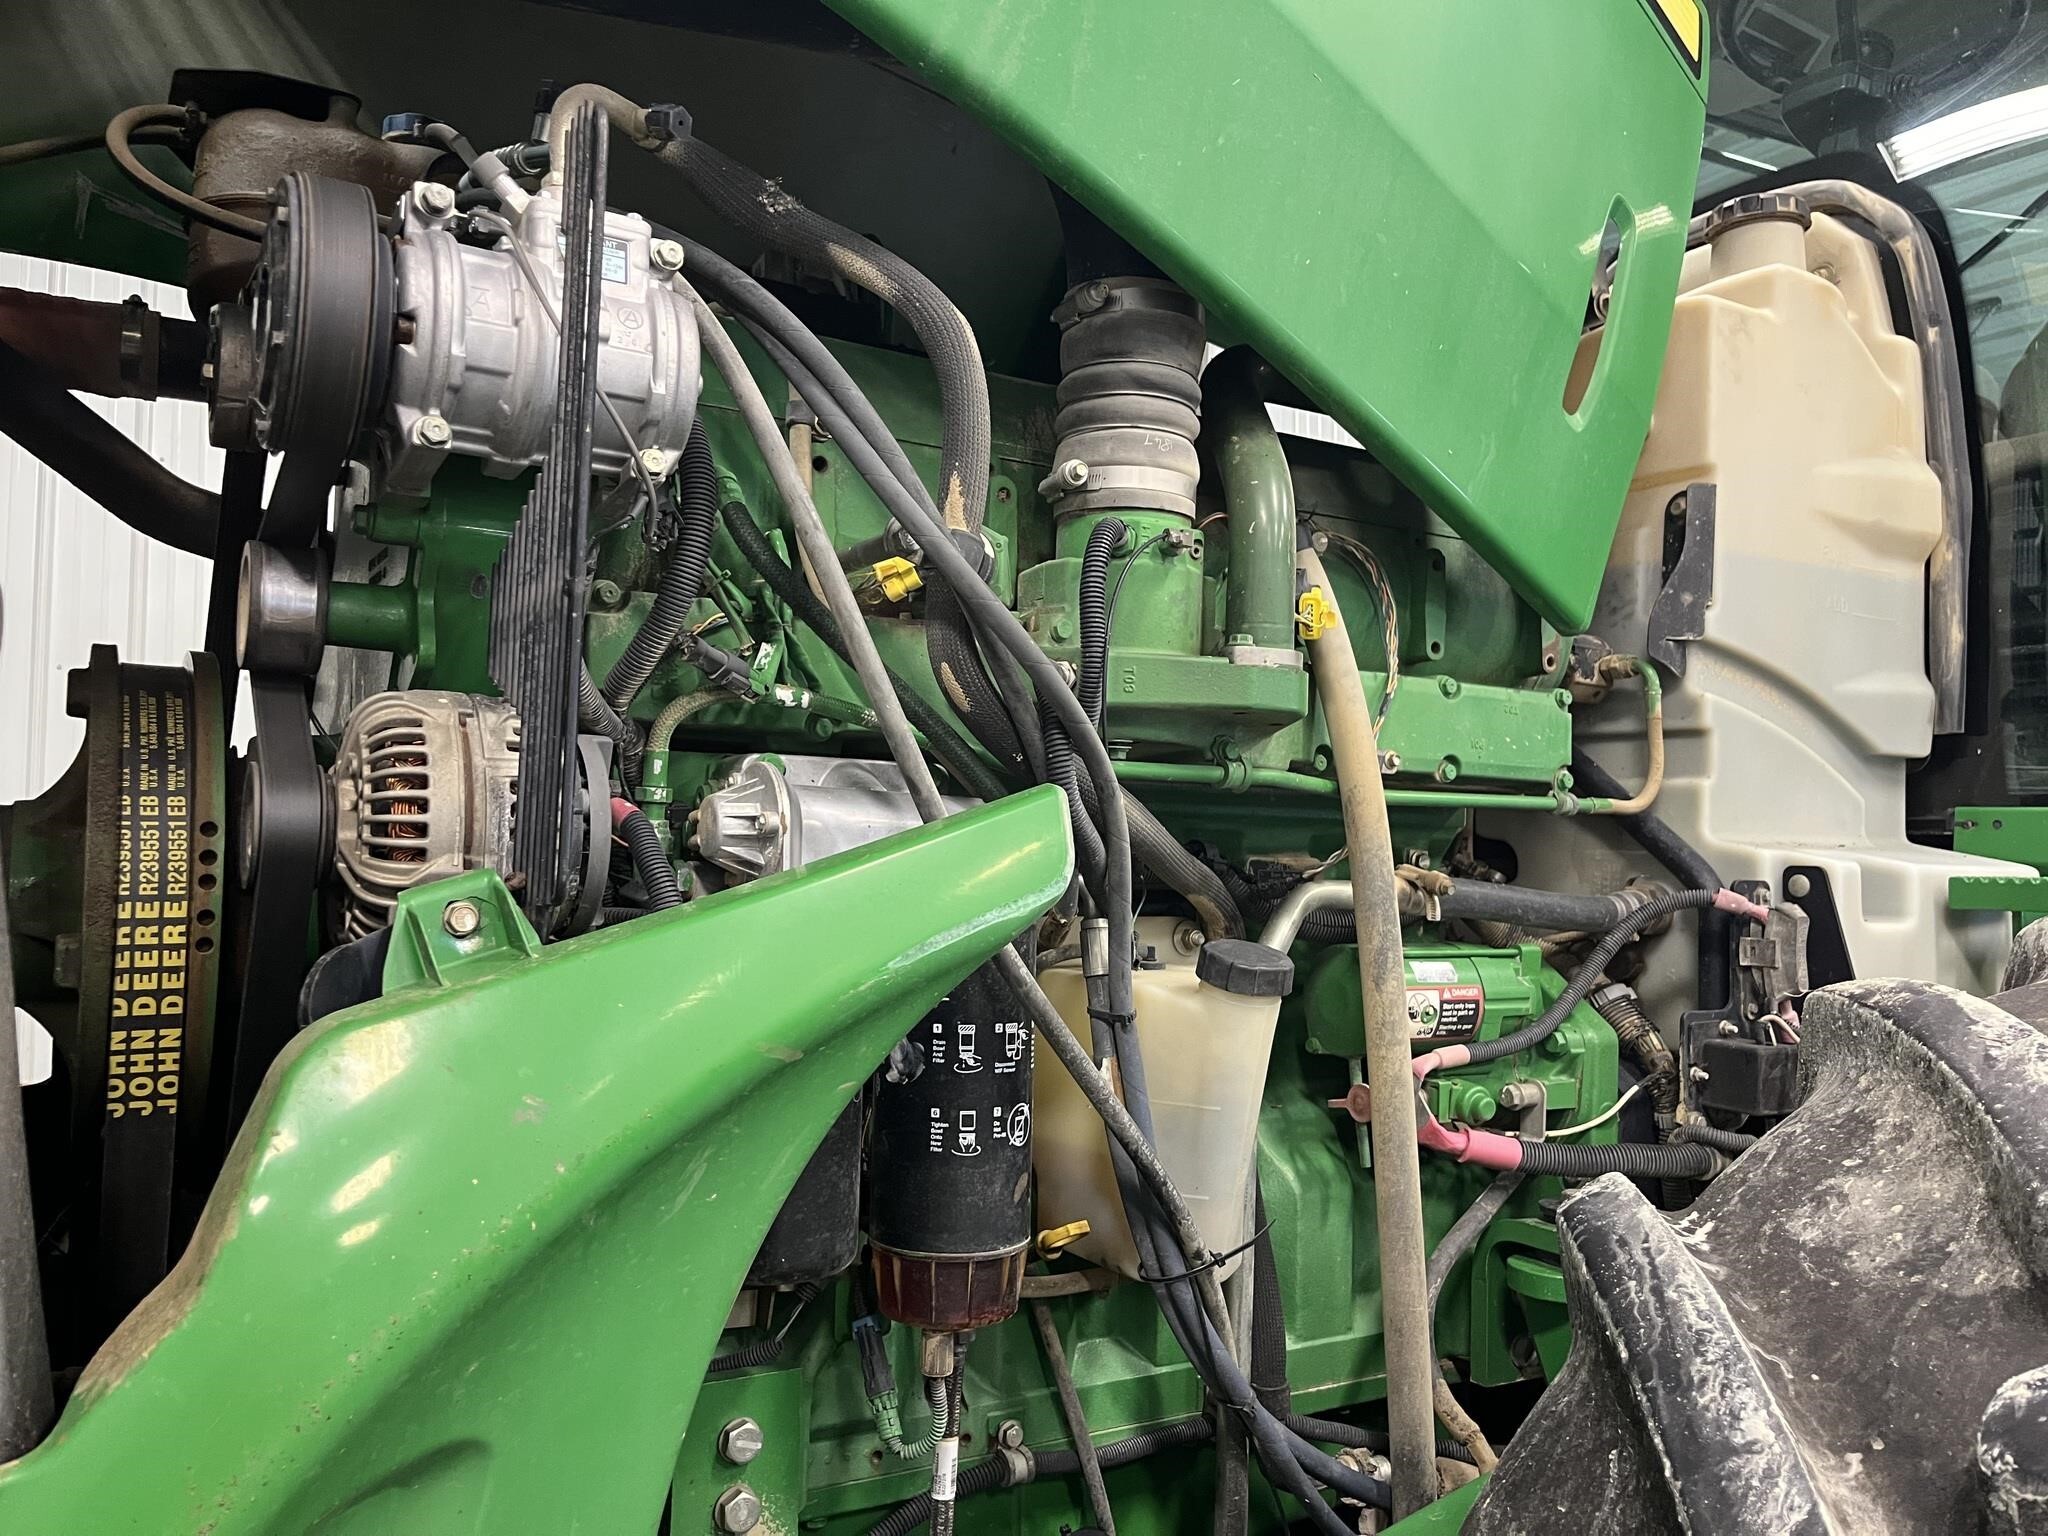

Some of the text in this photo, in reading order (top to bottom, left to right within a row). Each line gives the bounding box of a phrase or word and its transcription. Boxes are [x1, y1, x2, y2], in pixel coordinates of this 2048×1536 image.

[140, 772, 149, 790] MADE
[168, 772, 177, 791] MADE
[128, 795, 160, 1116] JOHN DEERE R239551 EB
[157, 795, 188, 1114] JOHN DEERE R239551 EB
[1452, 988, 1479, 997] DANGER
